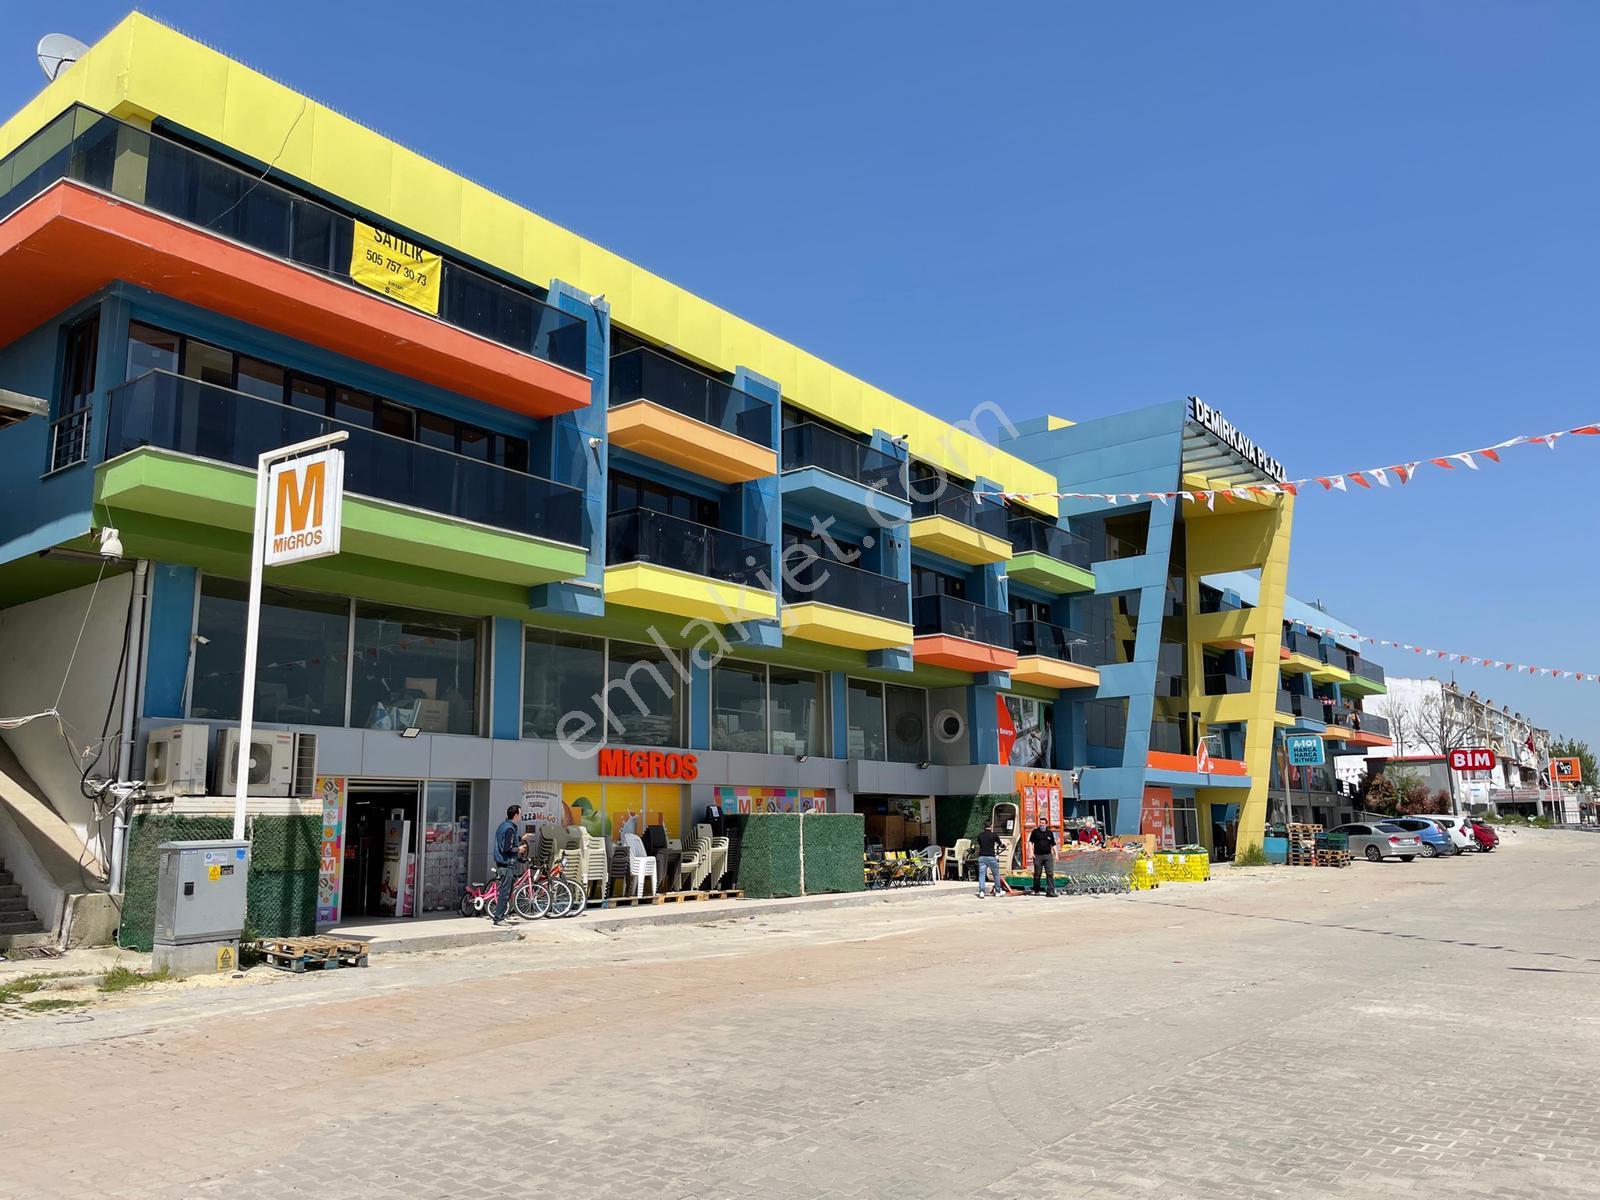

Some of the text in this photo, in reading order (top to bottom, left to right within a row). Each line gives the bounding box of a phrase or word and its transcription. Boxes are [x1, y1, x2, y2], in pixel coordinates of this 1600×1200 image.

[366, 249, 383, 266] 505
[386, 257, 402, 274] 757
[403, 267, 415, 280] 30
[416, 272, 427, 286] 73
[374, 228, 424, 263] SATILIK
[1192, 396, 1288, 483] DEMİRKAYA PLAZA
[274, 461, 326, 536] M
